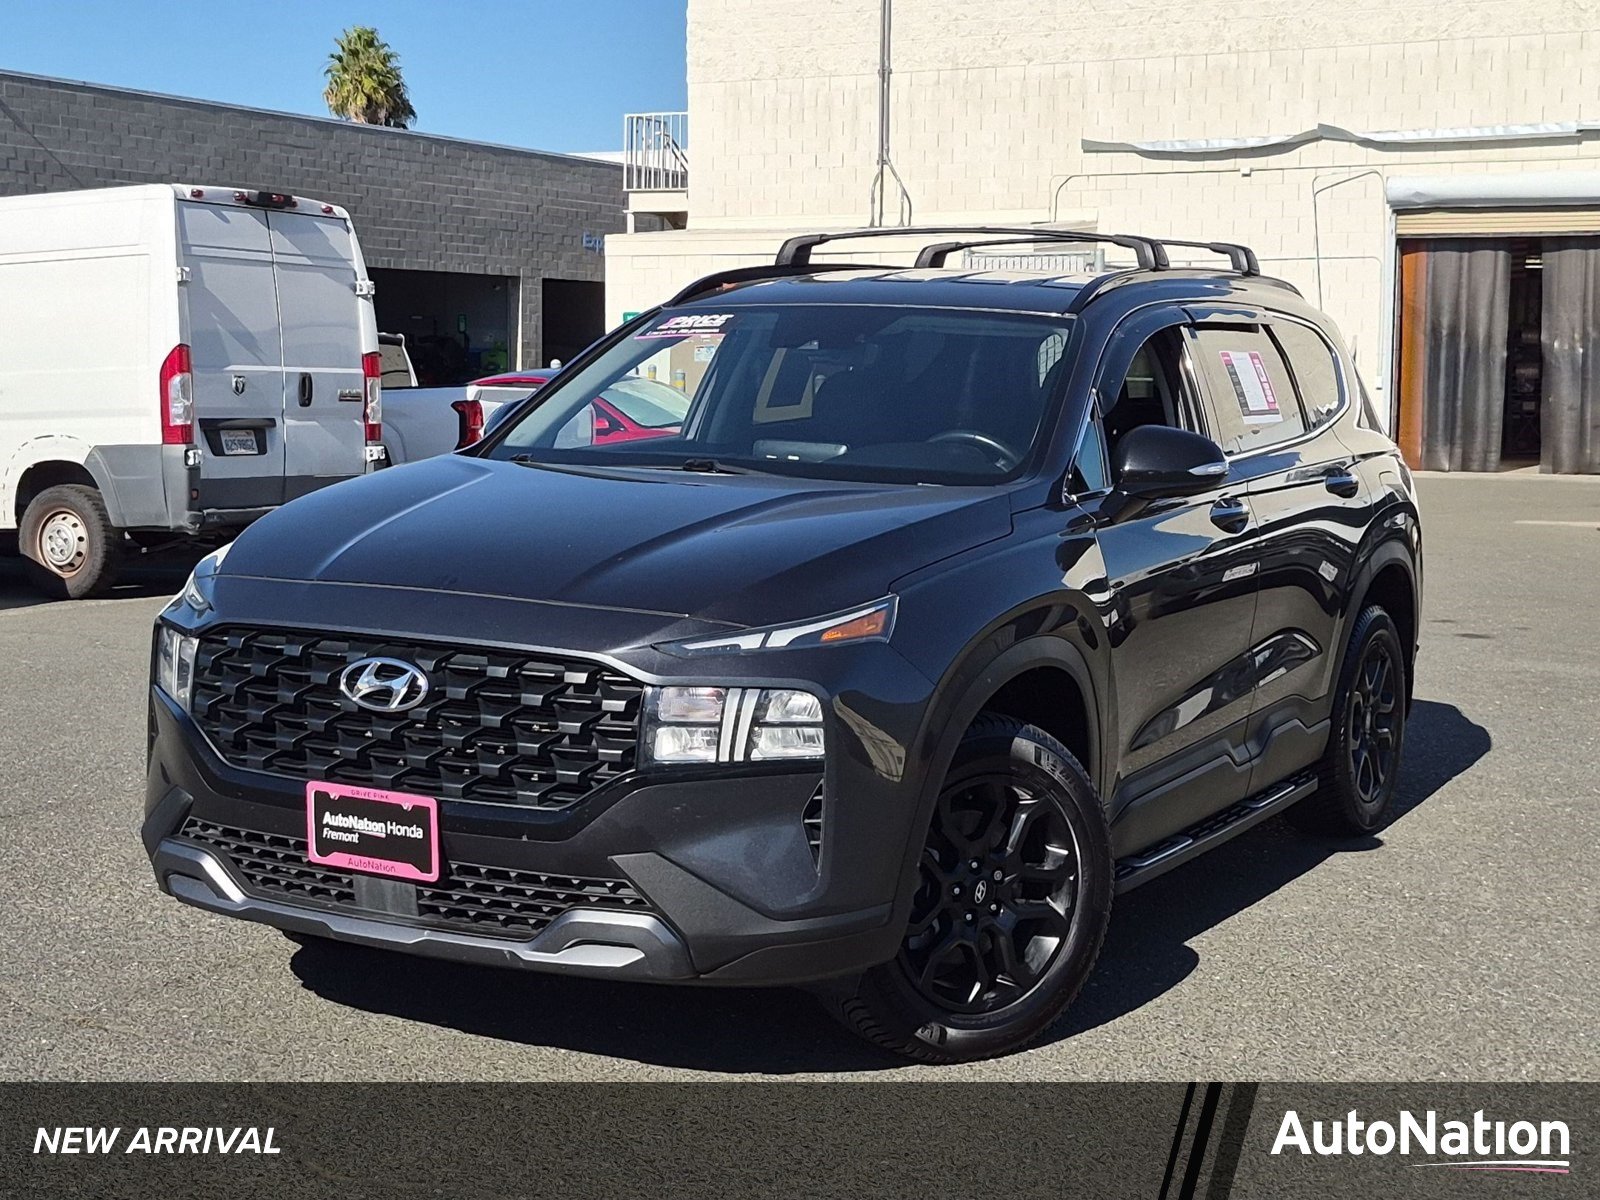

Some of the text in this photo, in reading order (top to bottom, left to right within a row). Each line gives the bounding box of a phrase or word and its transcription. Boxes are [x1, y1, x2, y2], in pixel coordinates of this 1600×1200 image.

[583, 232, 604, 253] Exp
[322, 811, 424, 839] AutoNation Honda
[322, 827, 360, 843] Fremont
[347, 857, 396, 873] AutoNation
